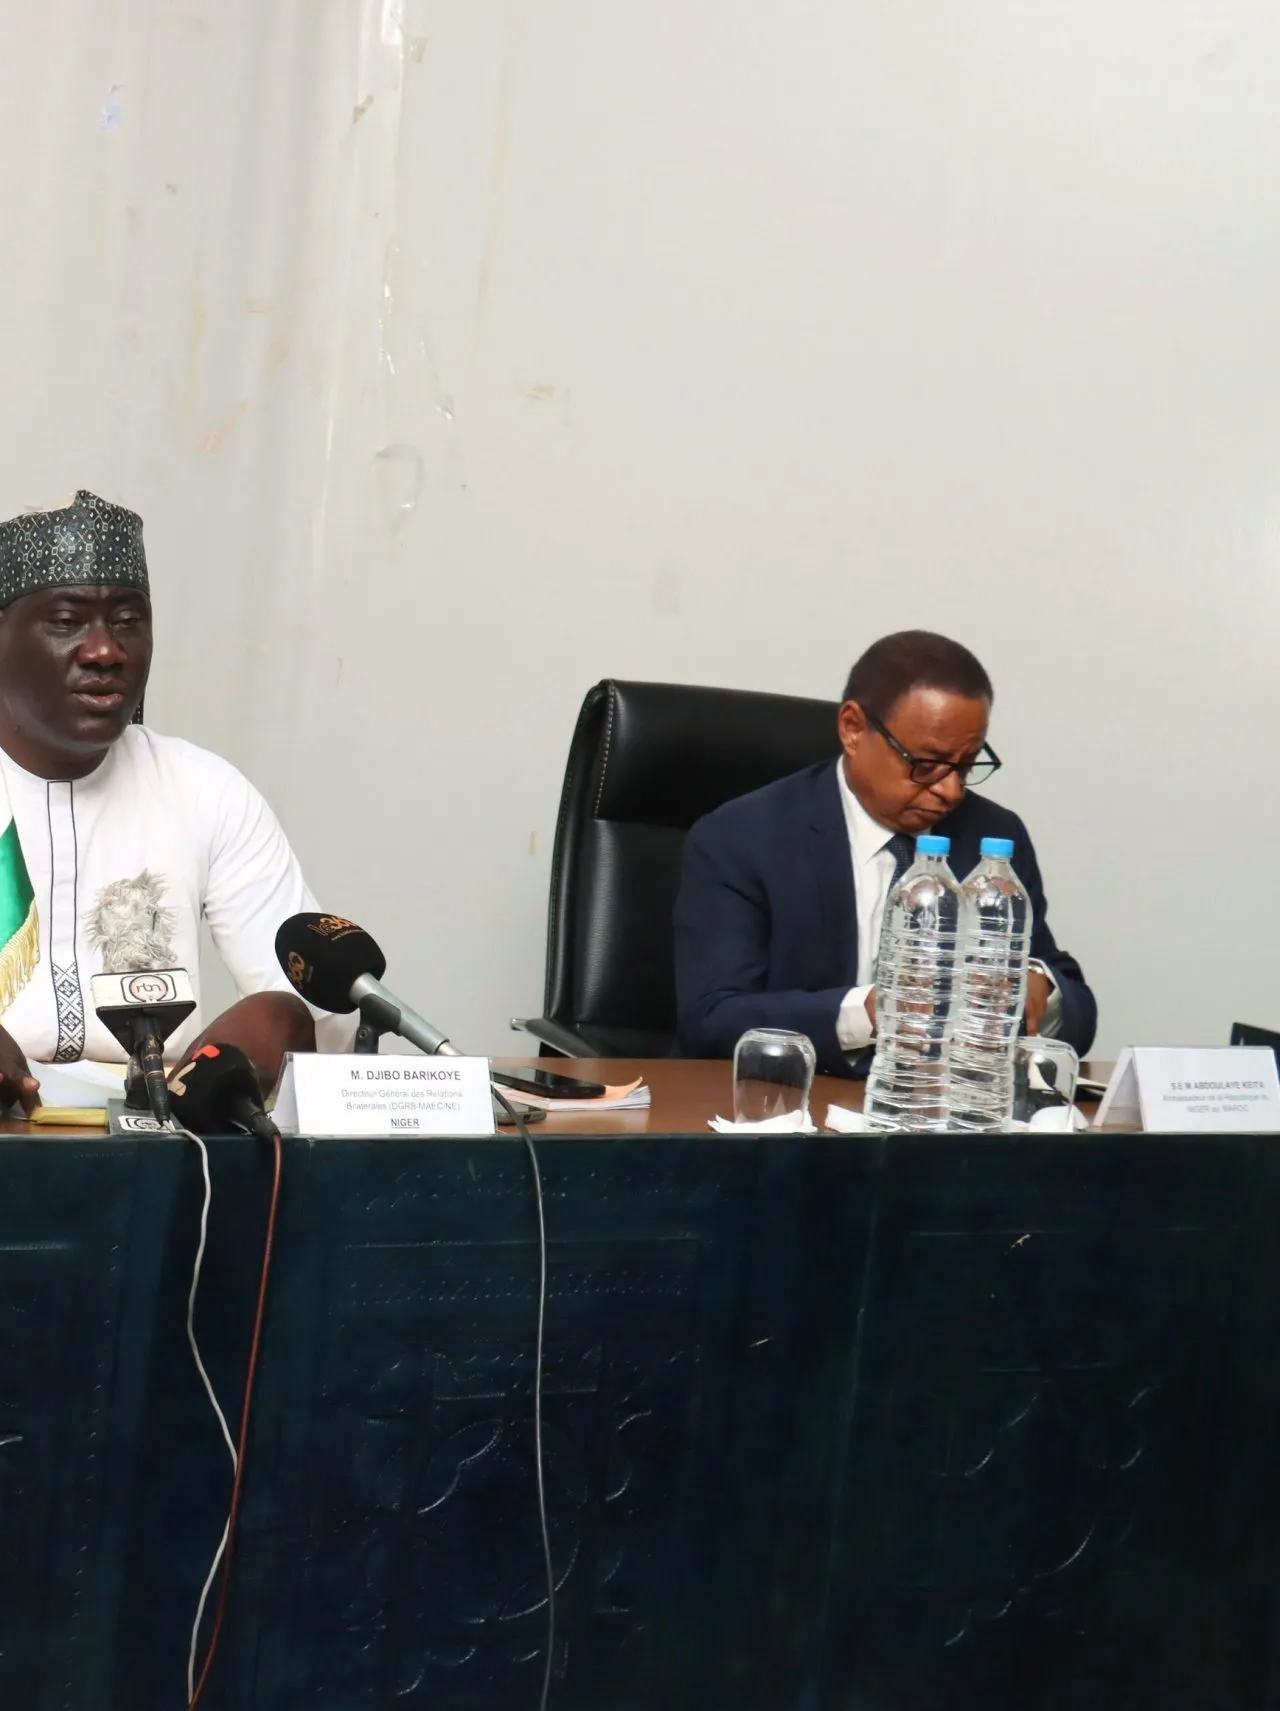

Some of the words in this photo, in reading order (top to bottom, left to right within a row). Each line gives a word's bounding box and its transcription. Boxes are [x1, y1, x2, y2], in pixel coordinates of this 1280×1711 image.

[350, 1070, 364, 1081] M.
[366, 1070, 401, 1081] DJIBO
[404, 1071, 462, 1081] BARIKOYE
[341, 1089, 378, 1098] Directeur
[411, 1089, 426, 1098] des
[427, 1089, 464, 1098] Relations
[390, 1118, 420, 1128] NIGER
